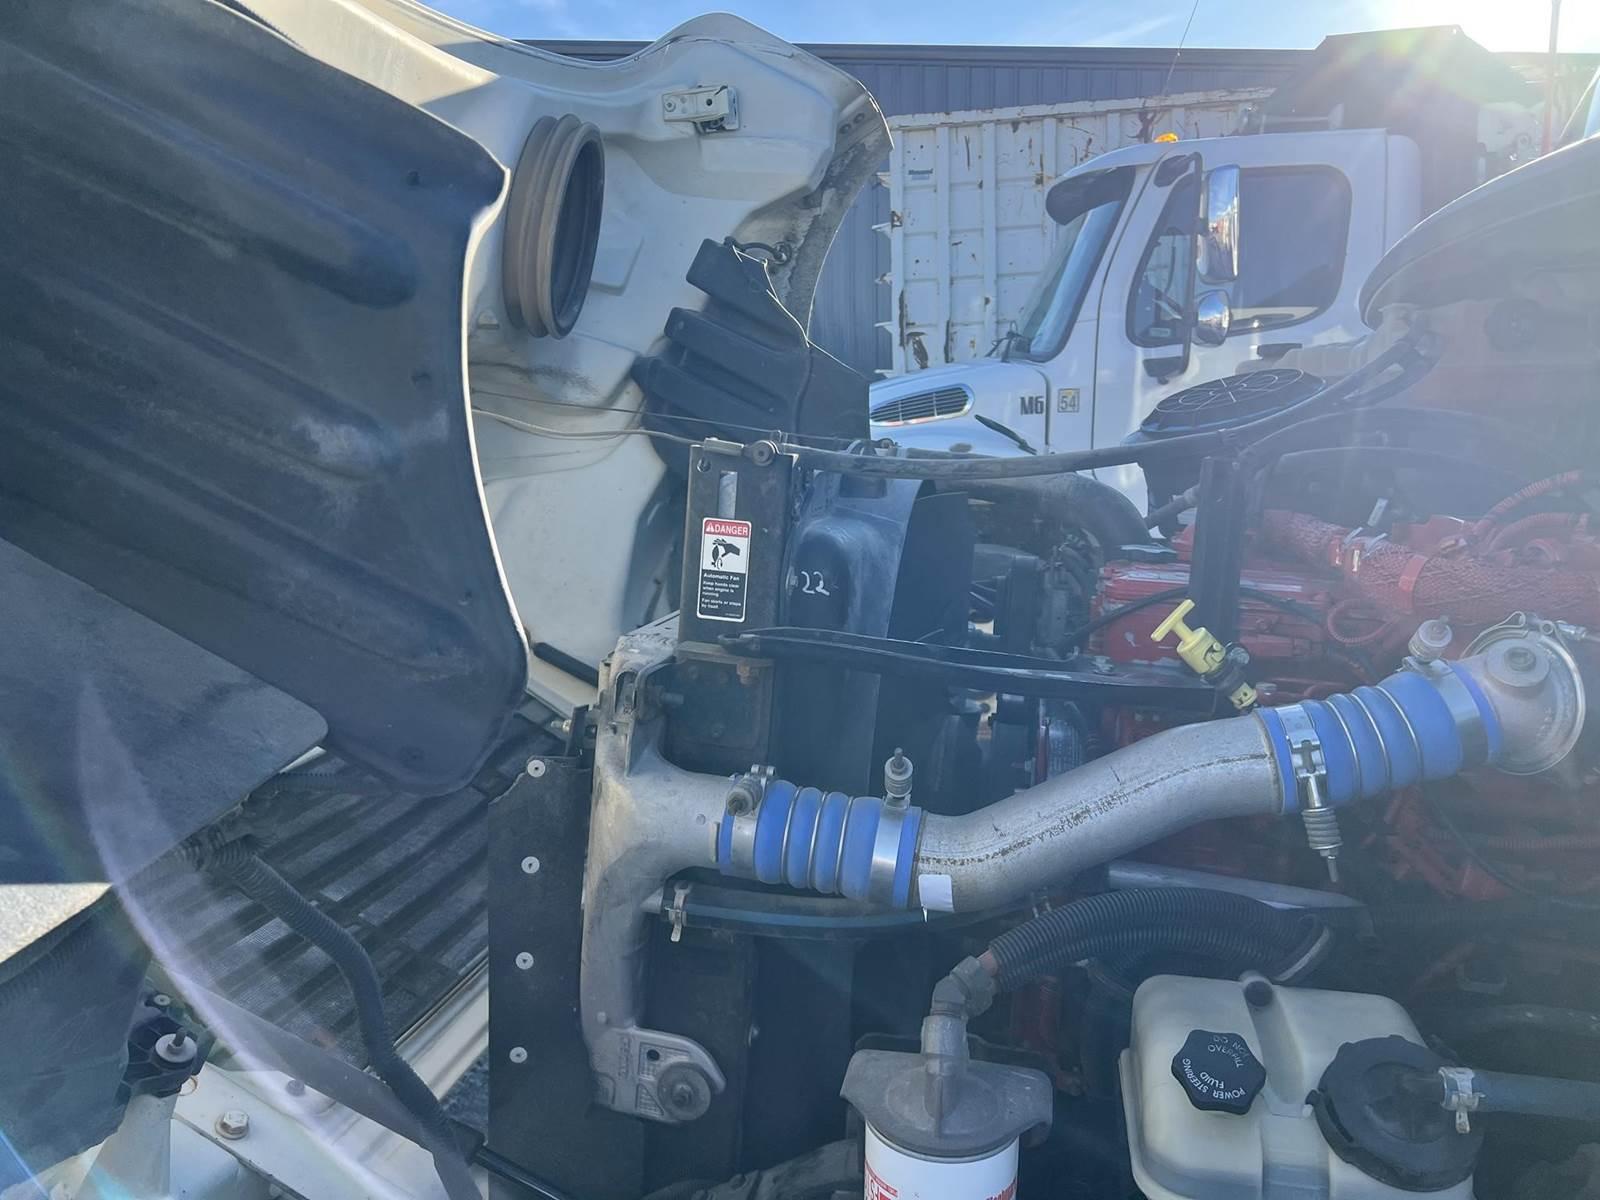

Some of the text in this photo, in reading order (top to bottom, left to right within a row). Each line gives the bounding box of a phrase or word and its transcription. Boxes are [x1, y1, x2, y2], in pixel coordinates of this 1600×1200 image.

[1020, 396, 1044, 415] M6
[1060, 395, 1077, 411] 54
[714, 526, 748, 536] DANGER
[703, 572, 729, 580] Automatic
[801, 571, 830, 596] 22
[1182, 1057, 1247, 1100] POWER STEERING
[1199, 1071, 1225, 1090] FLUID
